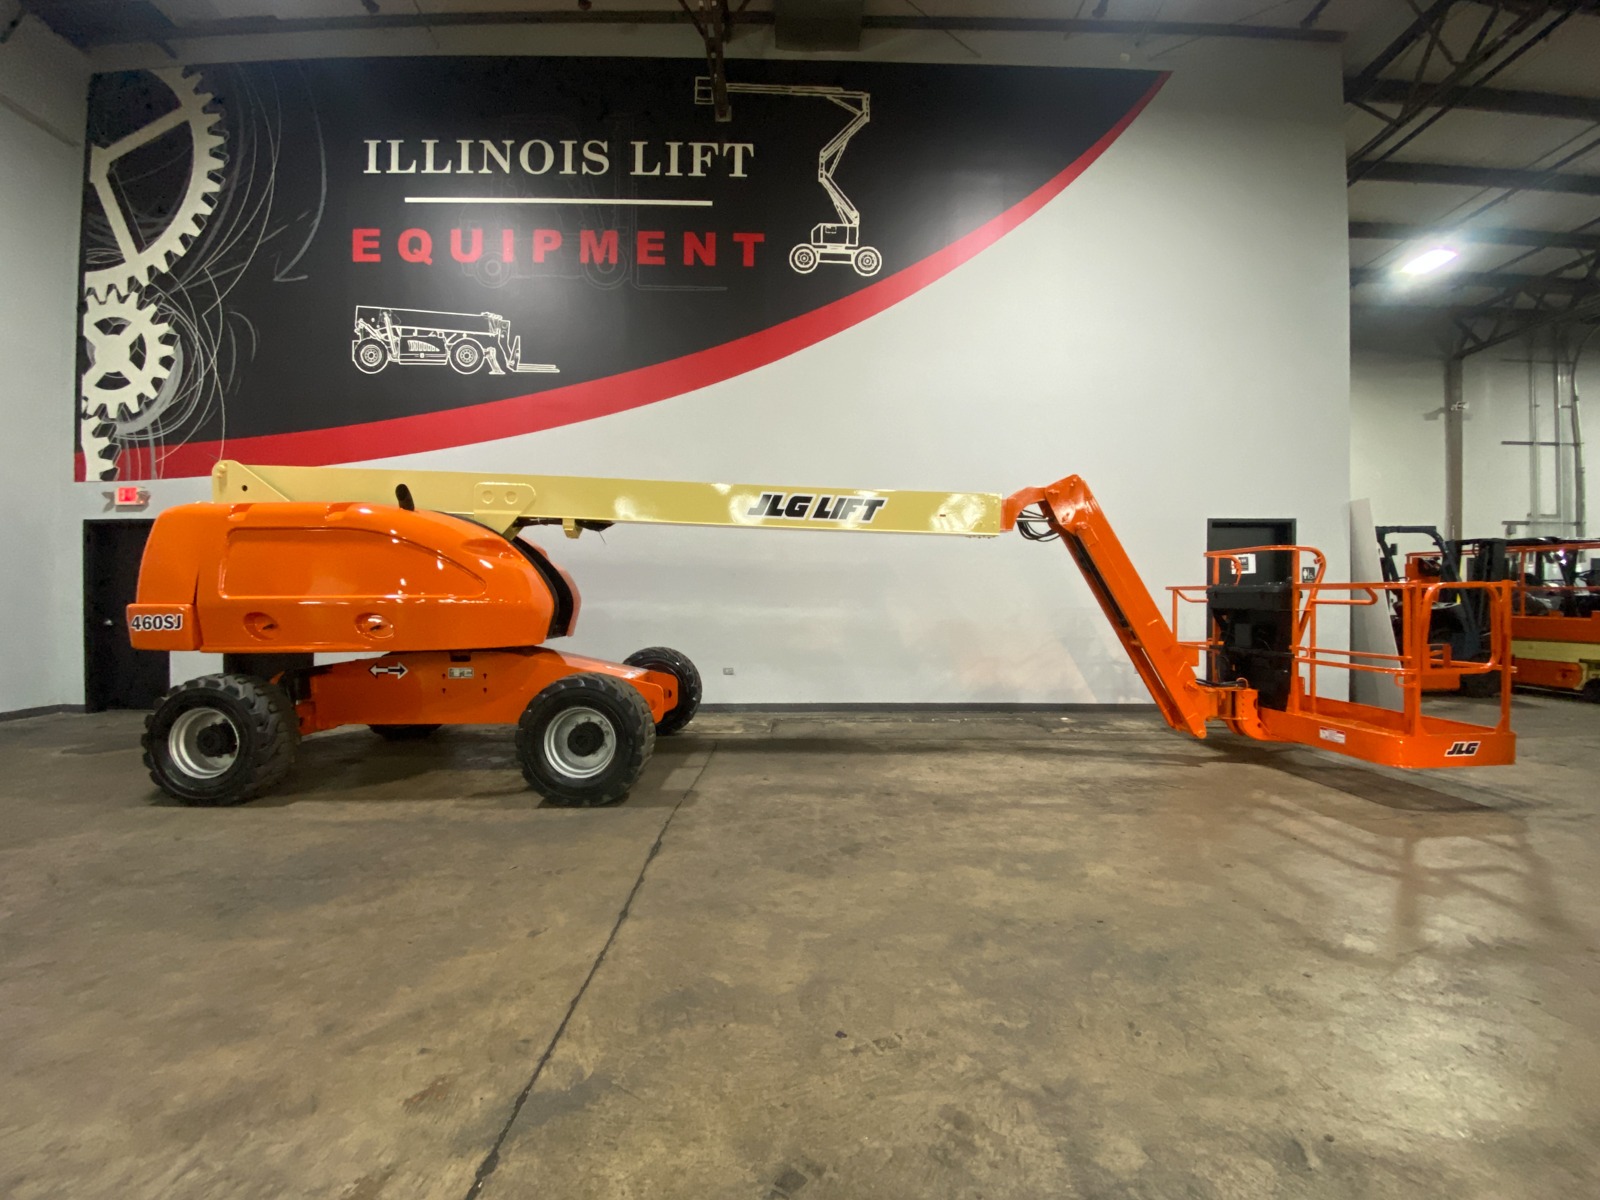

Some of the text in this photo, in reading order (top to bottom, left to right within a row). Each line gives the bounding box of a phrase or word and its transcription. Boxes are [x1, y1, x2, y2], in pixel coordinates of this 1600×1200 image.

[363, 139, 755, 178] ILLINOIS LIFT
[351, 228, 766, 267] EQUIPMENT
[747, 493, 887, 521] JLG LIFT
[131, 615, 182, 630] 460SJ
[1446, 742, 1479, 756] JLG
